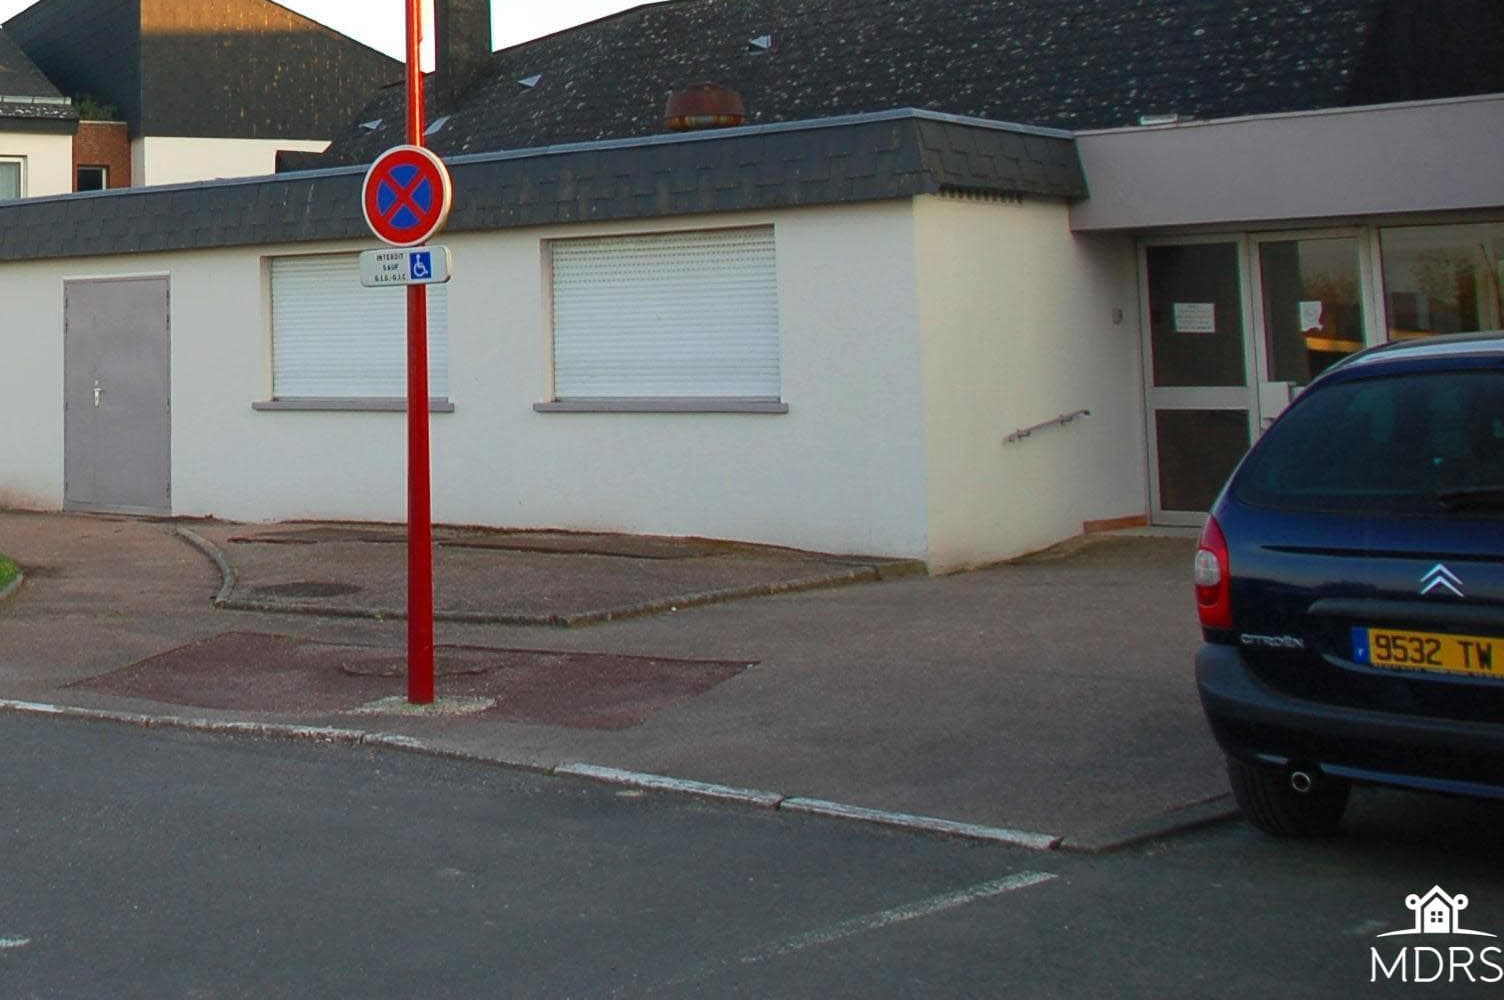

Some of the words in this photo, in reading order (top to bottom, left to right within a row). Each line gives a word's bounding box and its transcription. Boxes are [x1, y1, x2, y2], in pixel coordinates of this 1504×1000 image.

[376, 252, 404, 262] INTERDIT
[1374, 633, 1442, 666] 9532
[1458, 640, 1493, 670] TW
